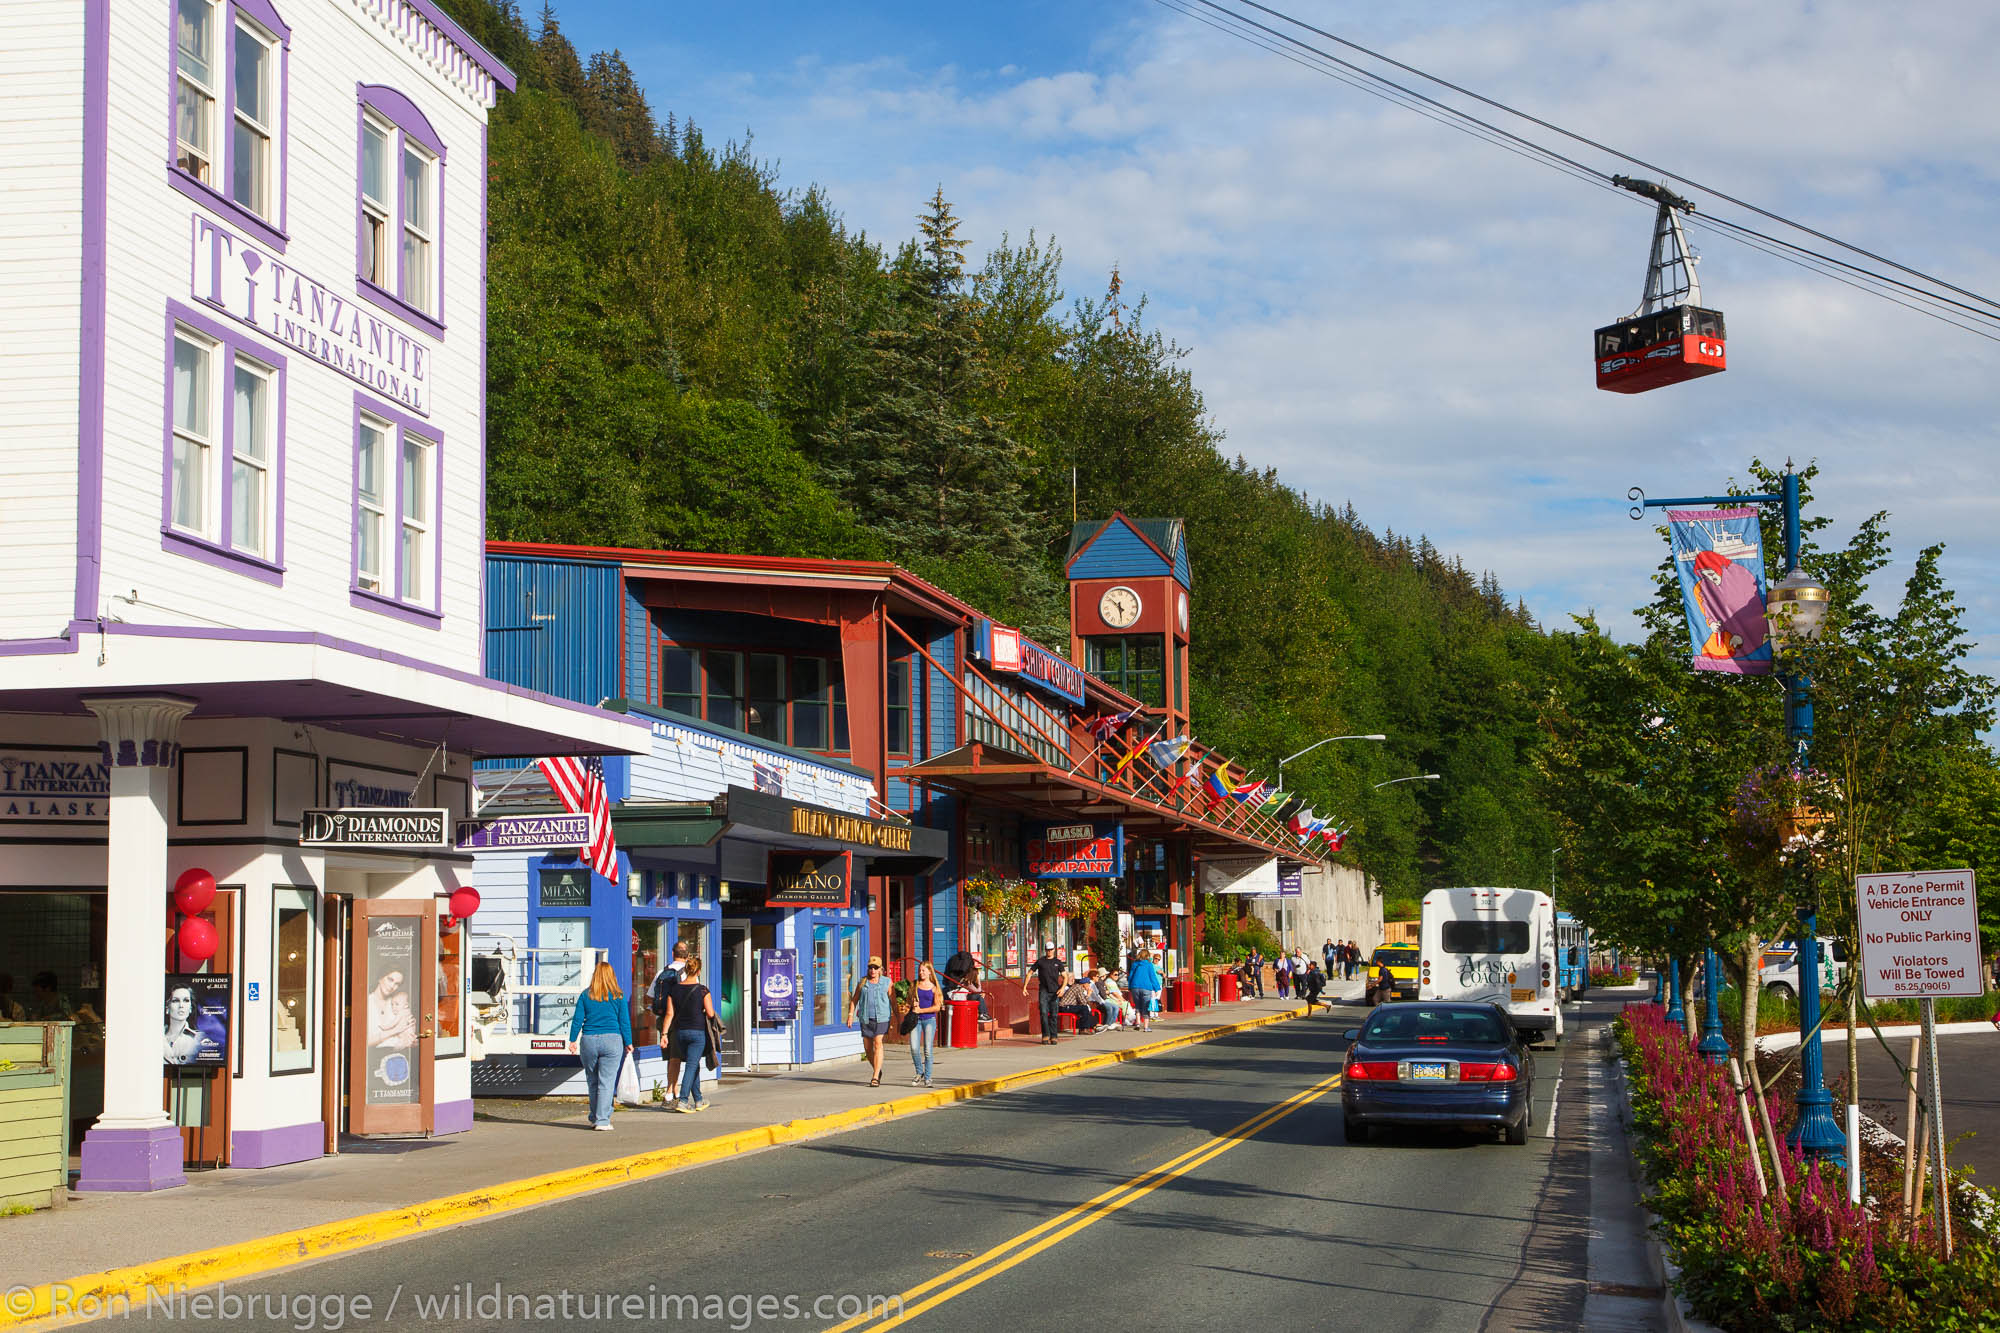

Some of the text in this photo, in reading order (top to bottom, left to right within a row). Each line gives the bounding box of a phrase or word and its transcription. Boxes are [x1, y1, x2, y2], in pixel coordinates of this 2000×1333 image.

[271, 261, 424, 382] TANZANITE
[273, 312, 422, 409] INTERNATIONAL
[1022, 644, 1048, 681] SHIRT
[20, 761, 109, 780] TANZAN
[348, 817, 441, 833] DIAMONDS
[498, 819, 586, 835] TANZANITE
[348, 833, 440, 843] INTERNATIONAL
[498, 833, 588, 845] INTERNATIONAL
[1050, 826, 1091, 840] ALASKA
[1029, 861, 1113, 873] COMPANY
[776, 874, 842, 890] MILANO
[1866, 880, 1965, 896] A/B Zone Permit
[1868, 896, 1965, 910] Vehicle Entrance
[1900, 910, 1933, 922] ONLY
[1866, 930, 1972, 944] No Public Parking
[1892, 955, 1948, 967] Violators
[1879, 967, 1965, 980] Will Be Towed
[556, 996, 575, 1005] and
